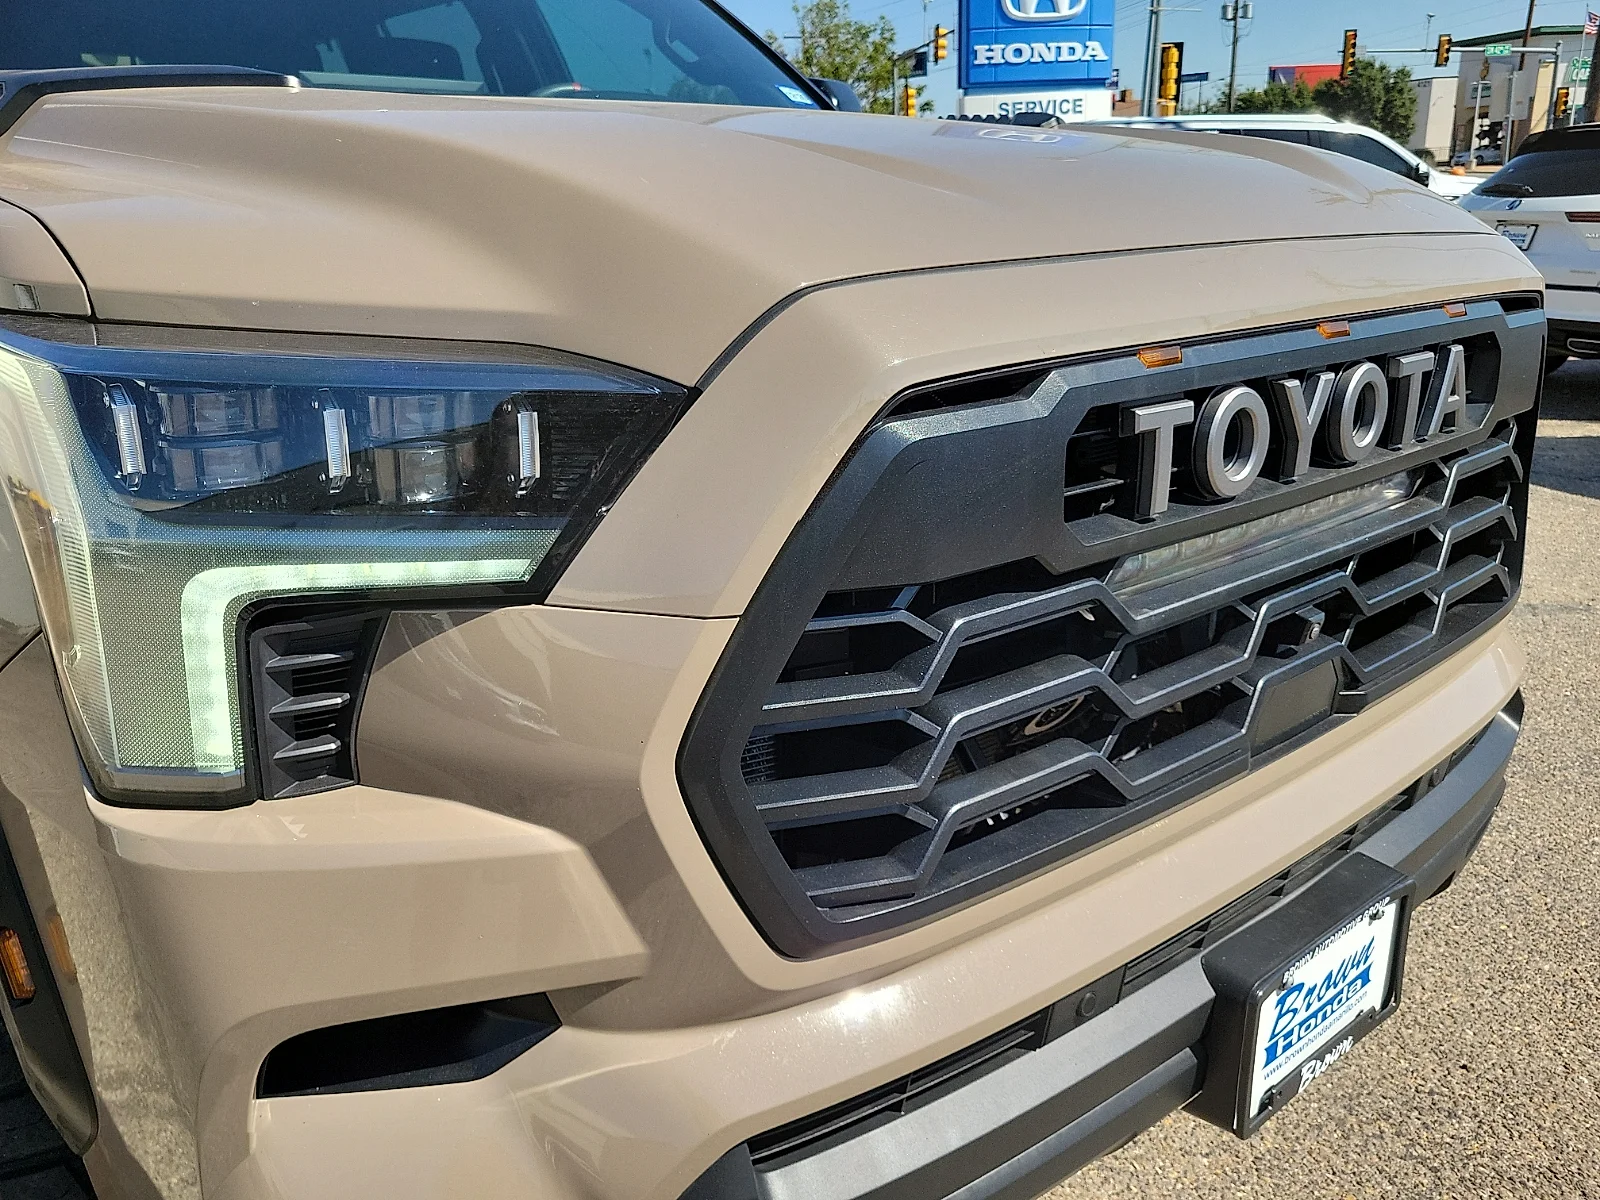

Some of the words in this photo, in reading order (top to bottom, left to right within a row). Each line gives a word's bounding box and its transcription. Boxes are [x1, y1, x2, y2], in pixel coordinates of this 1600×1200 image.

[973, 41, 1109, 64] HONDA
[999, 98, 1083, 117] SERVICE
[1133, 344, 1467, 517] TOYOTA
[1282, 951, 1314, 984] BROWN
[1313, 914, 1364, 958] AUTOMOTIVE
[1362, 896, 1391, 921] GROUP
[1267, 935, 1375, 1043] Brown
[1274, 976, 1365, 1058] Honda
[1264, 990, 1368, 1081] www.brownhondaamarillo.com
[1298, 1035, 1354, 1094] Brown
